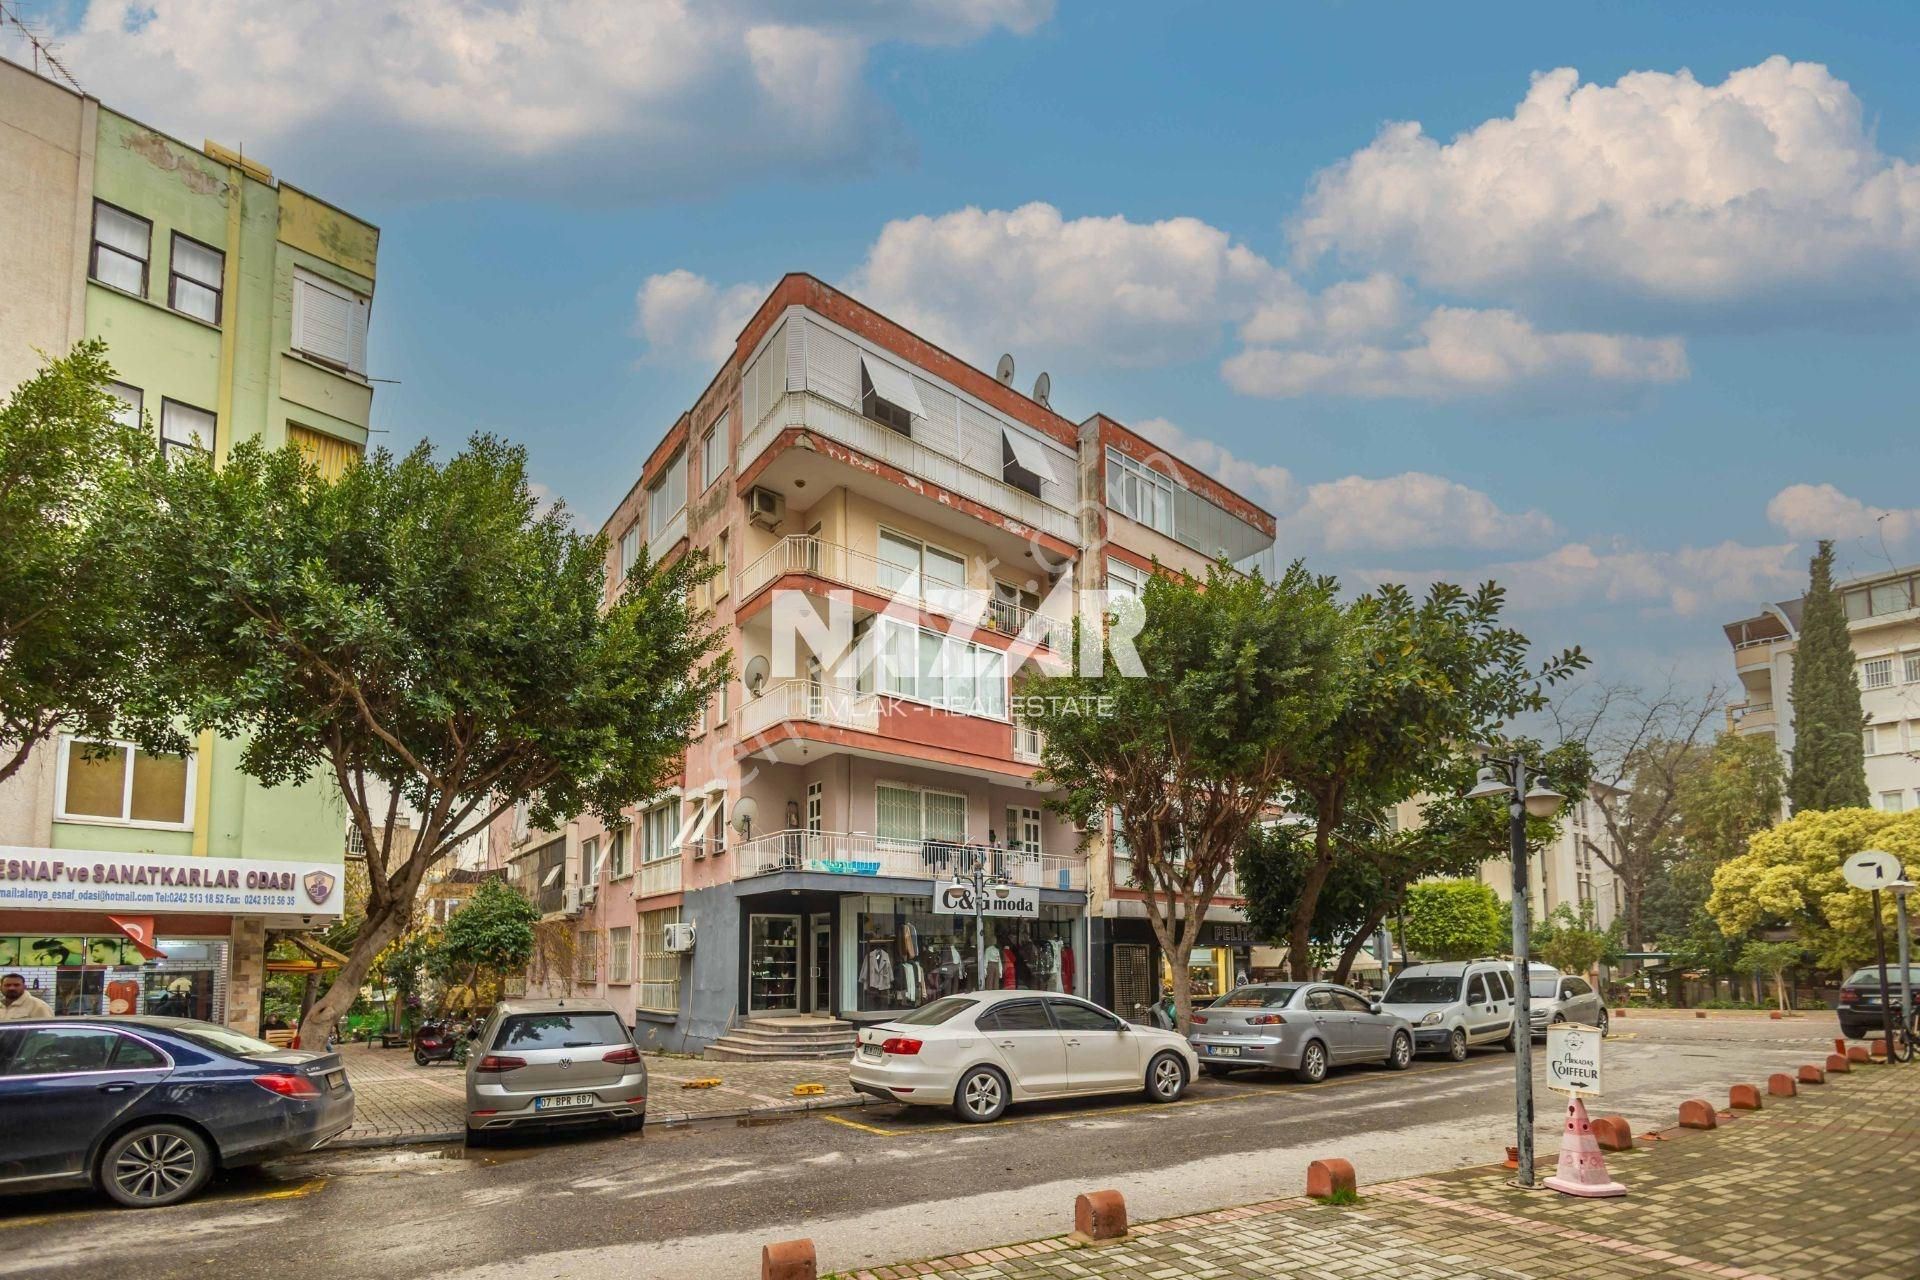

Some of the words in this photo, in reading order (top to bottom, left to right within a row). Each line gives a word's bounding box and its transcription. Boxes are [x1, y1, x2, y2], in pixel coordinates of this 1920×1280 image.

[66, 867, 89, 882] ve
[93, 864, 240, 889] SANATKARLAR
[246, 870, 296, 891] ODASI
[189, 893, 203, 904] 513
[205, 894, 214, 904] 18
[215, 894, 225, 904] 52
[244, 895, 262, 905] 0242
[994, 898, 1034, 912] moda
[1552, 1061, 1598, 1079] COIFFEUR
[541, 1098, 551, 1108] 07
[556, 1097, 572, 1106] BPR
